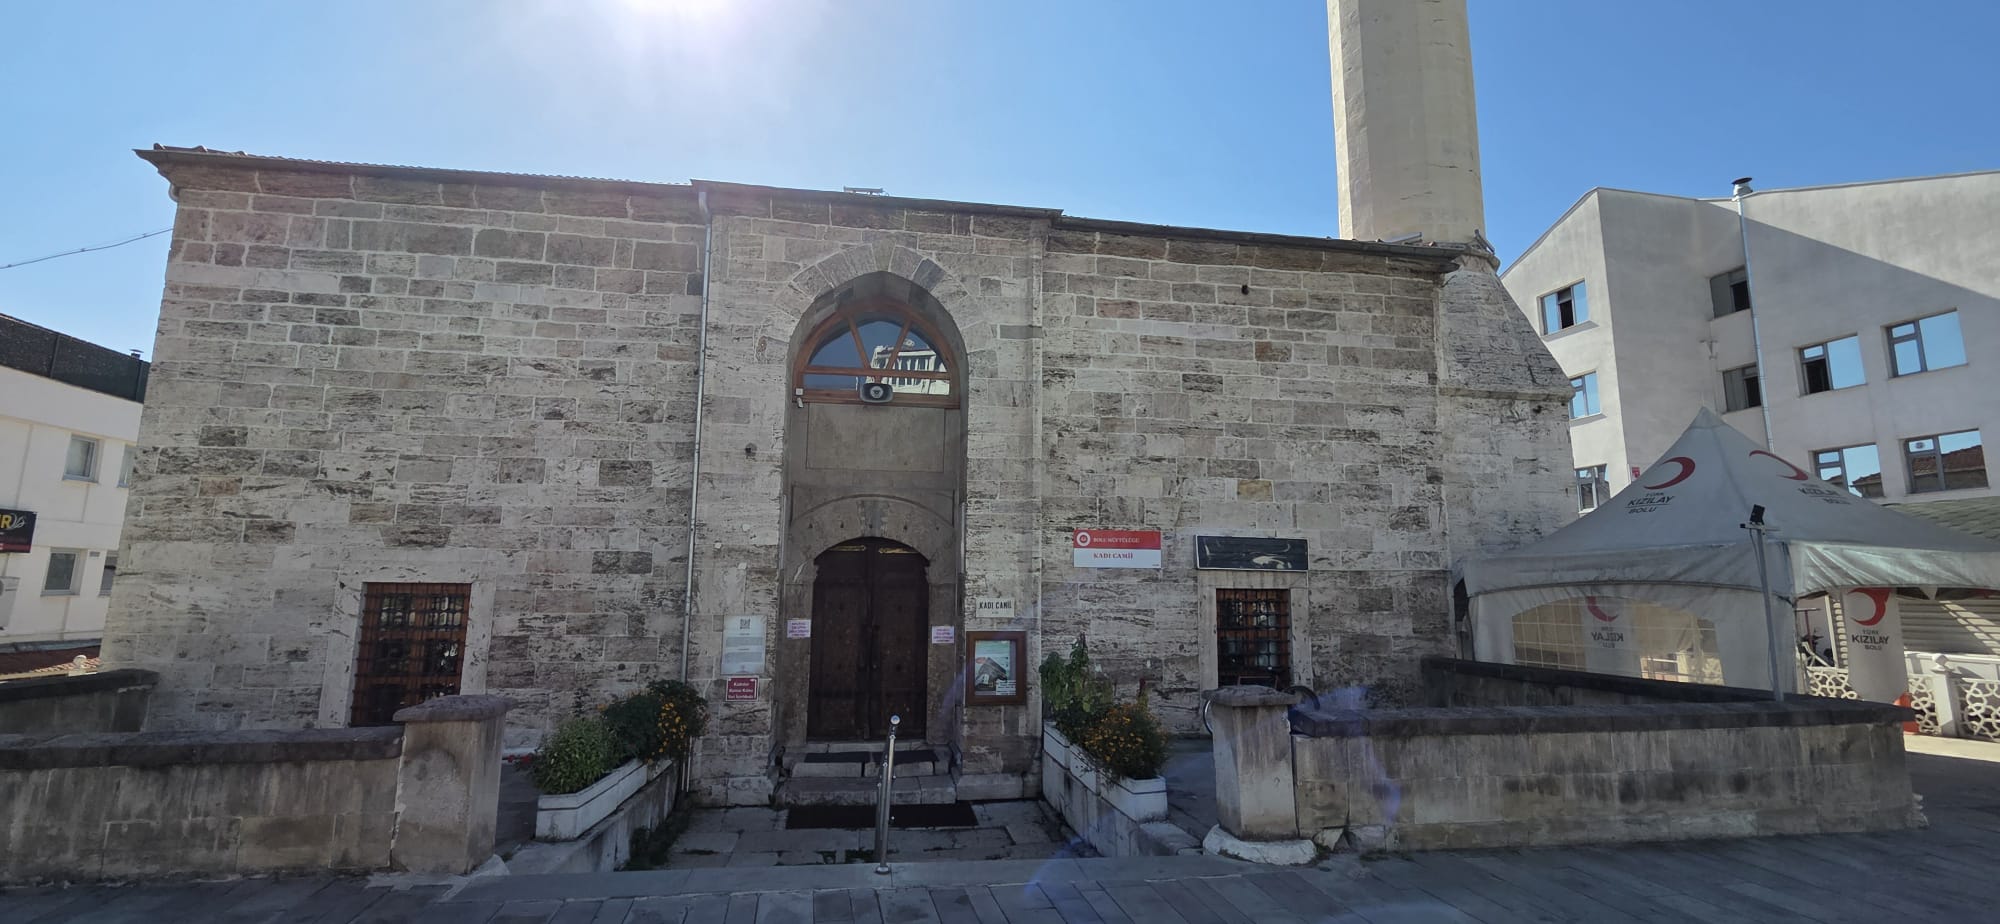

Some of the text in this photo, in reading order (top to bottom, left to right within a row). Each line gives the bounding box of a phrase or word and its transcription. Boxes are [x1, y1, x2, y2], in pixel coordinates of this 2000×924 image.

[1627, 495, 1675, 506] KIZILAY
[979, 601, 994, 609] KADI
[1851, 634, 1889, 645] KIZILAY
